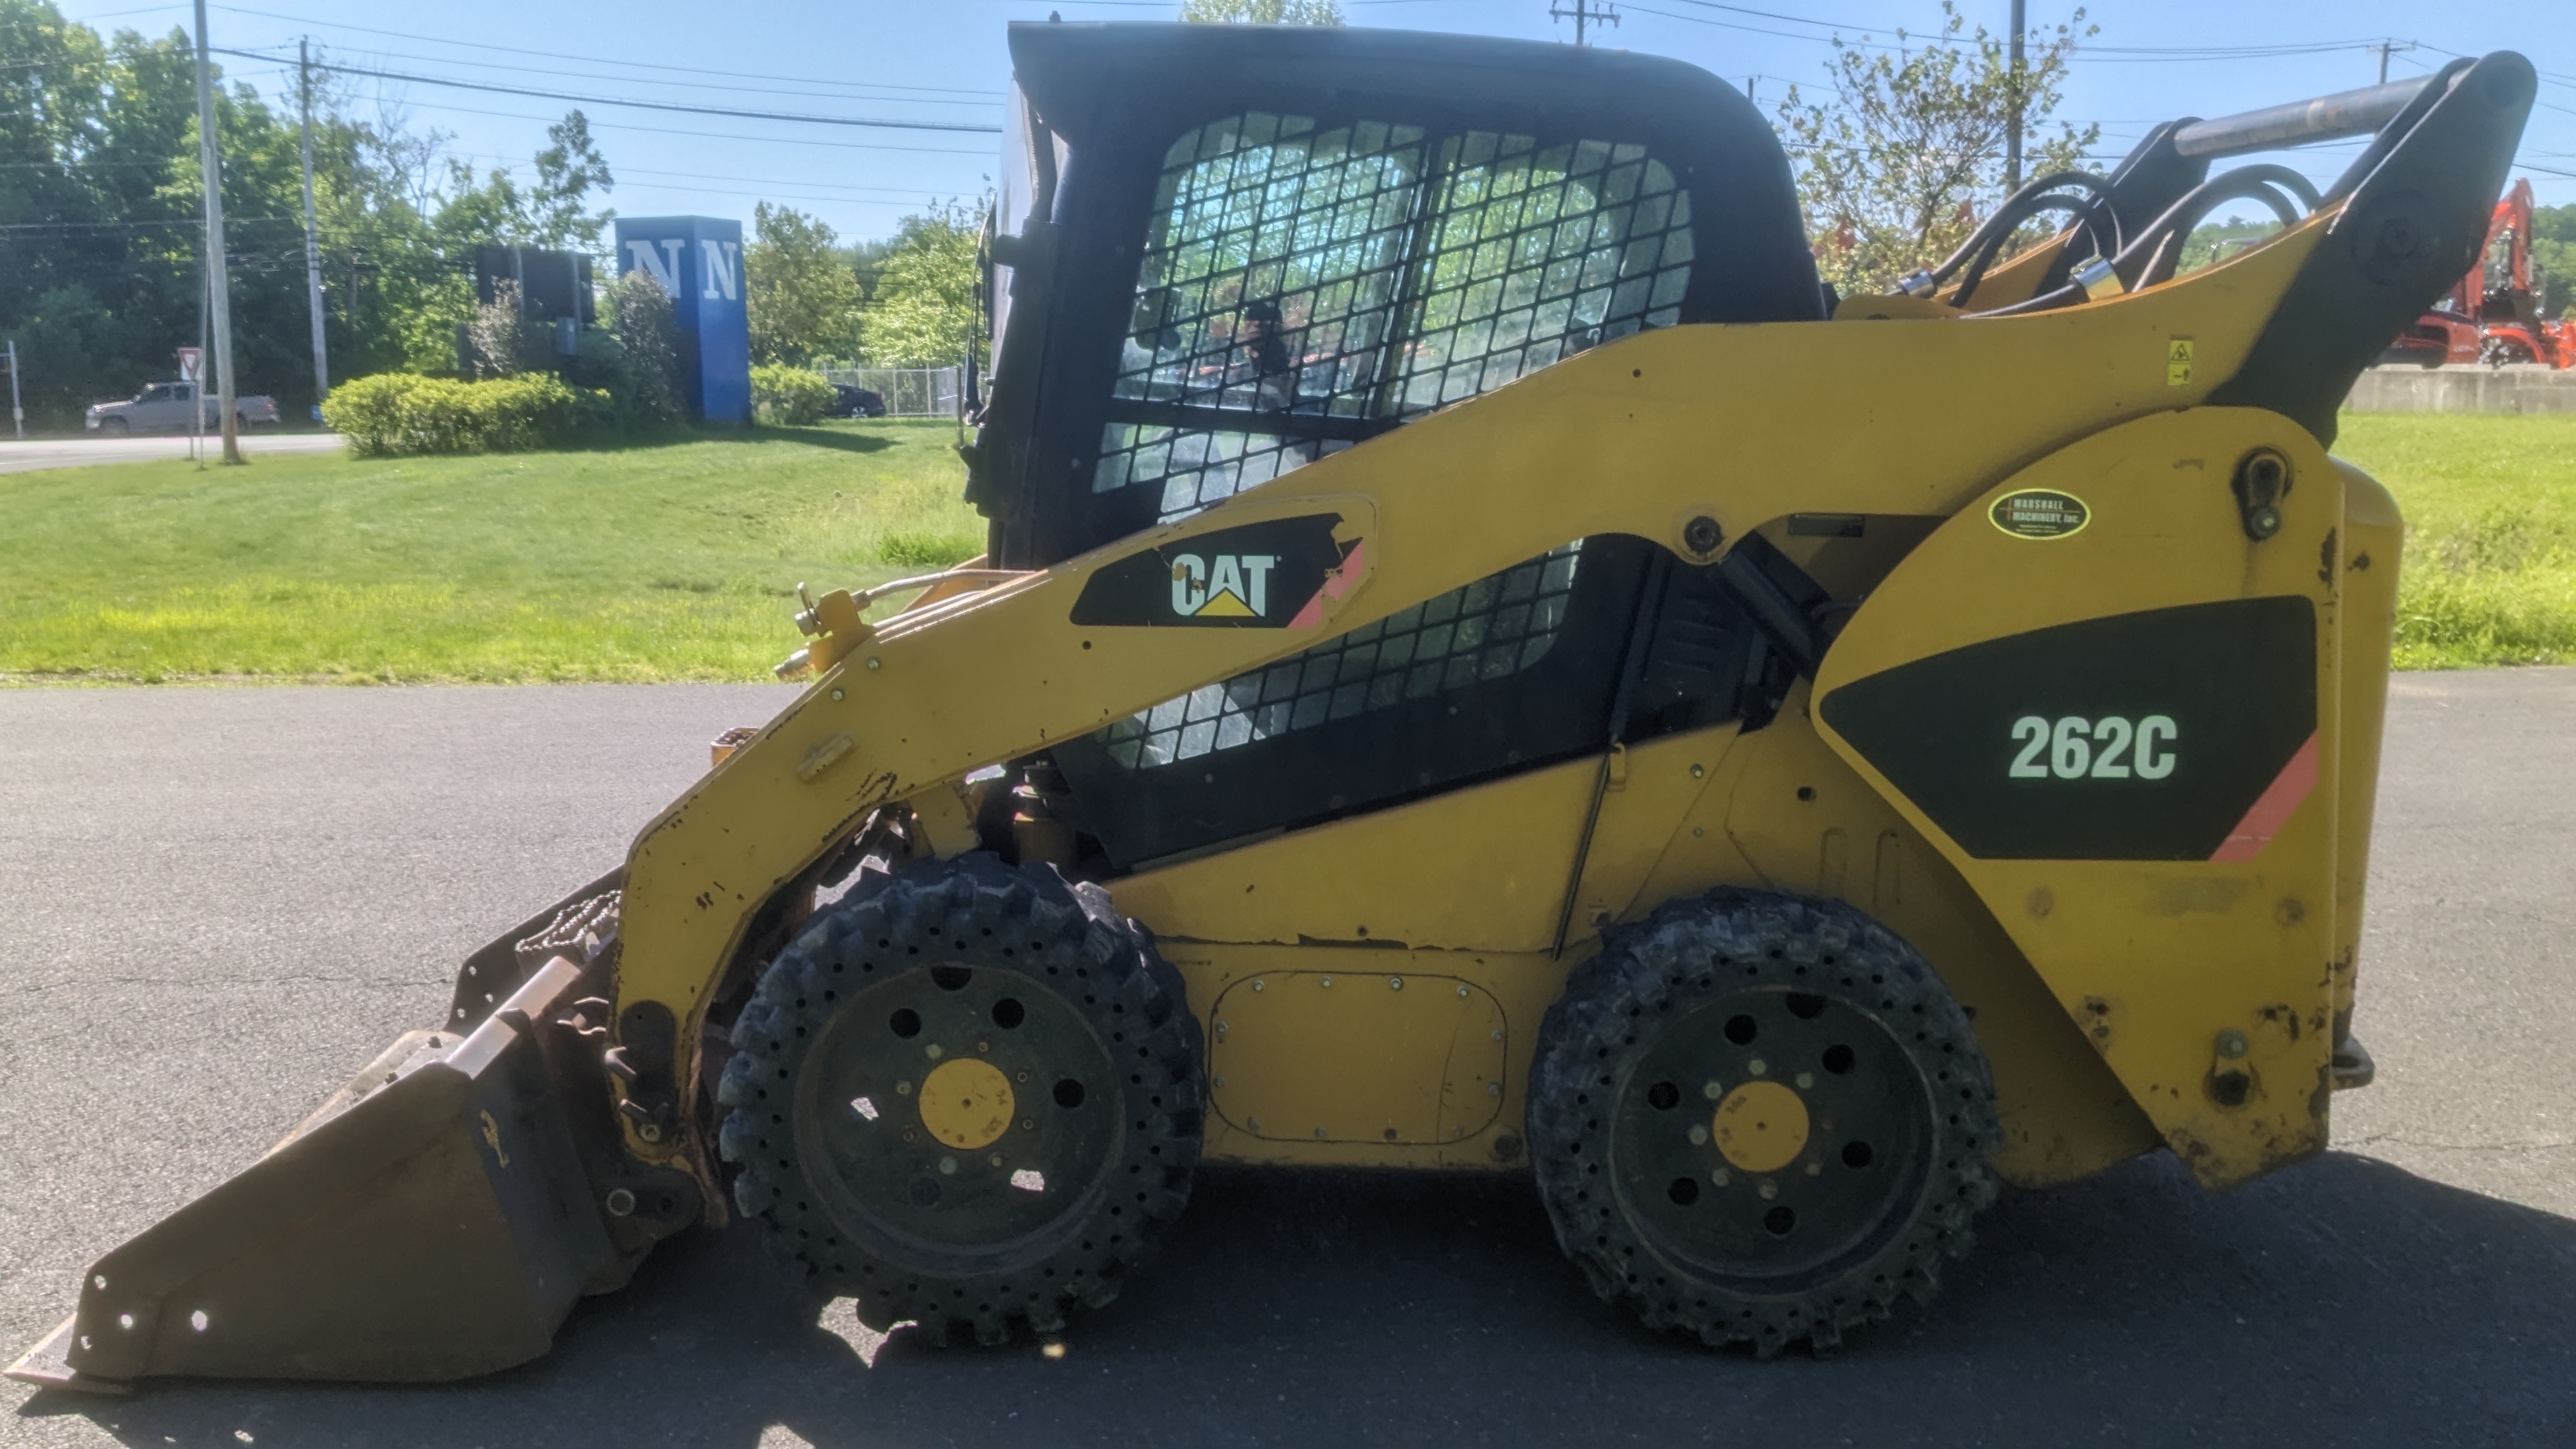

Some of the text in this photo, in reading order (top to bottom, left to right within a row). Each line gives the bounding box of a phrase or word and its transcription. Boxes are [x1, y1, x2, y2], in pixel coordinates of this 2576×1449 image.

[625, 239, 685, 299] N
[702, 240, 737, 300] N
[2014, 498, 2064, 510] MARSHALL
[1172, 554, 1275, 617] CAT
[2009, 715, 2177, 779] 262C
